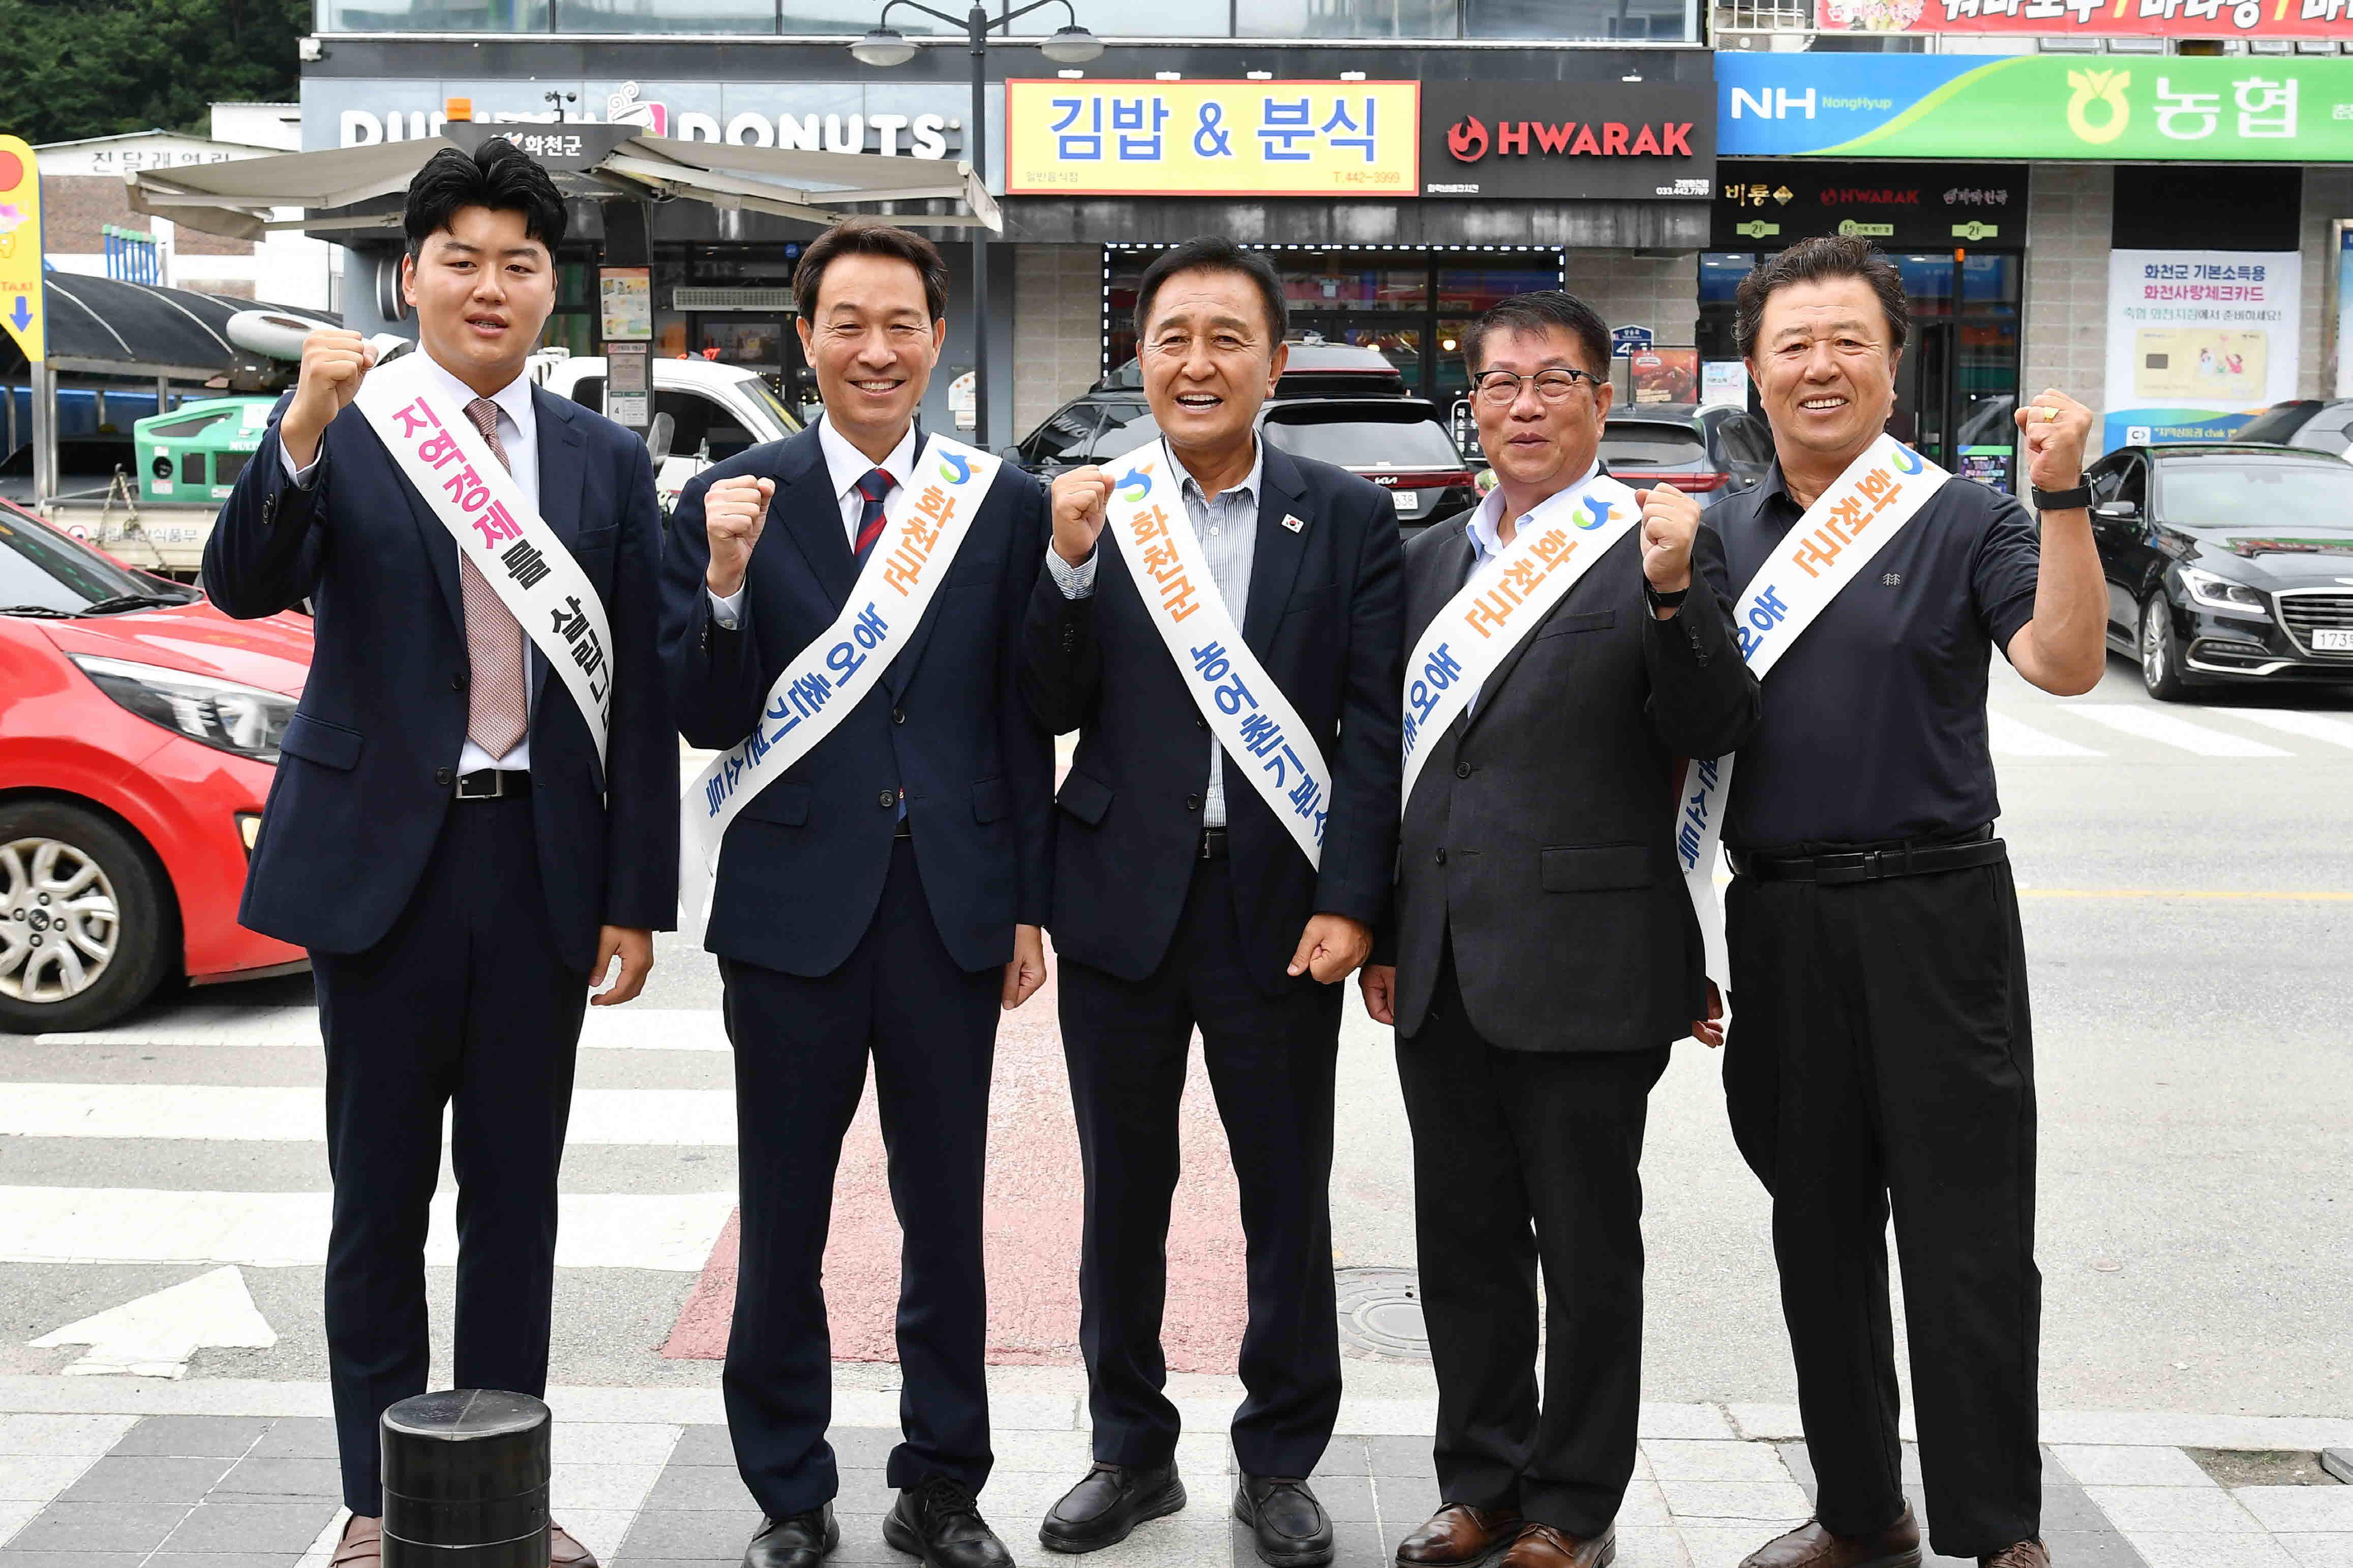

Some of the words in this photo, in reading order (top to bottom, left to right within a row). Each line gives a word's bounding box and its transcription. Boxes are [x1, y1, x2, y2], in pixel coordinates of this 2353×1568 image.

[1731, 87, 1816, 119] NH
[1822, 97, 1892, 110] NongHyup
[2153, 76, 2298, 140] 농협
[525, 135, 582, 156] 화천군
[678, 112, 947, 160] DONUTS
[1051, 97, 1169, 161] 김밥
[1194, 102, 1232, 157] &
[1258, 98, 1374, 162] 분식
[1498, 121, 1693, 156] HWARAK
[1725, 183, 1770, 207] 비룡
[1840, 190, 1920, 204] HWARAK
[2144, 264, 2189, 280] 화천군
[2193, 264, 2266, 282] 기본소득용
[2144, 285, 2264, 301] 화천사랑체크카드
[392, 396, 551, 590] 지역경제를
[884, 485, 956, 597] 화천군
[1793, 468, 1904, 578] 화천군
[1130, 504, 1200, 624] 화천군
[1464, 529, 1579, 639] 화천군
